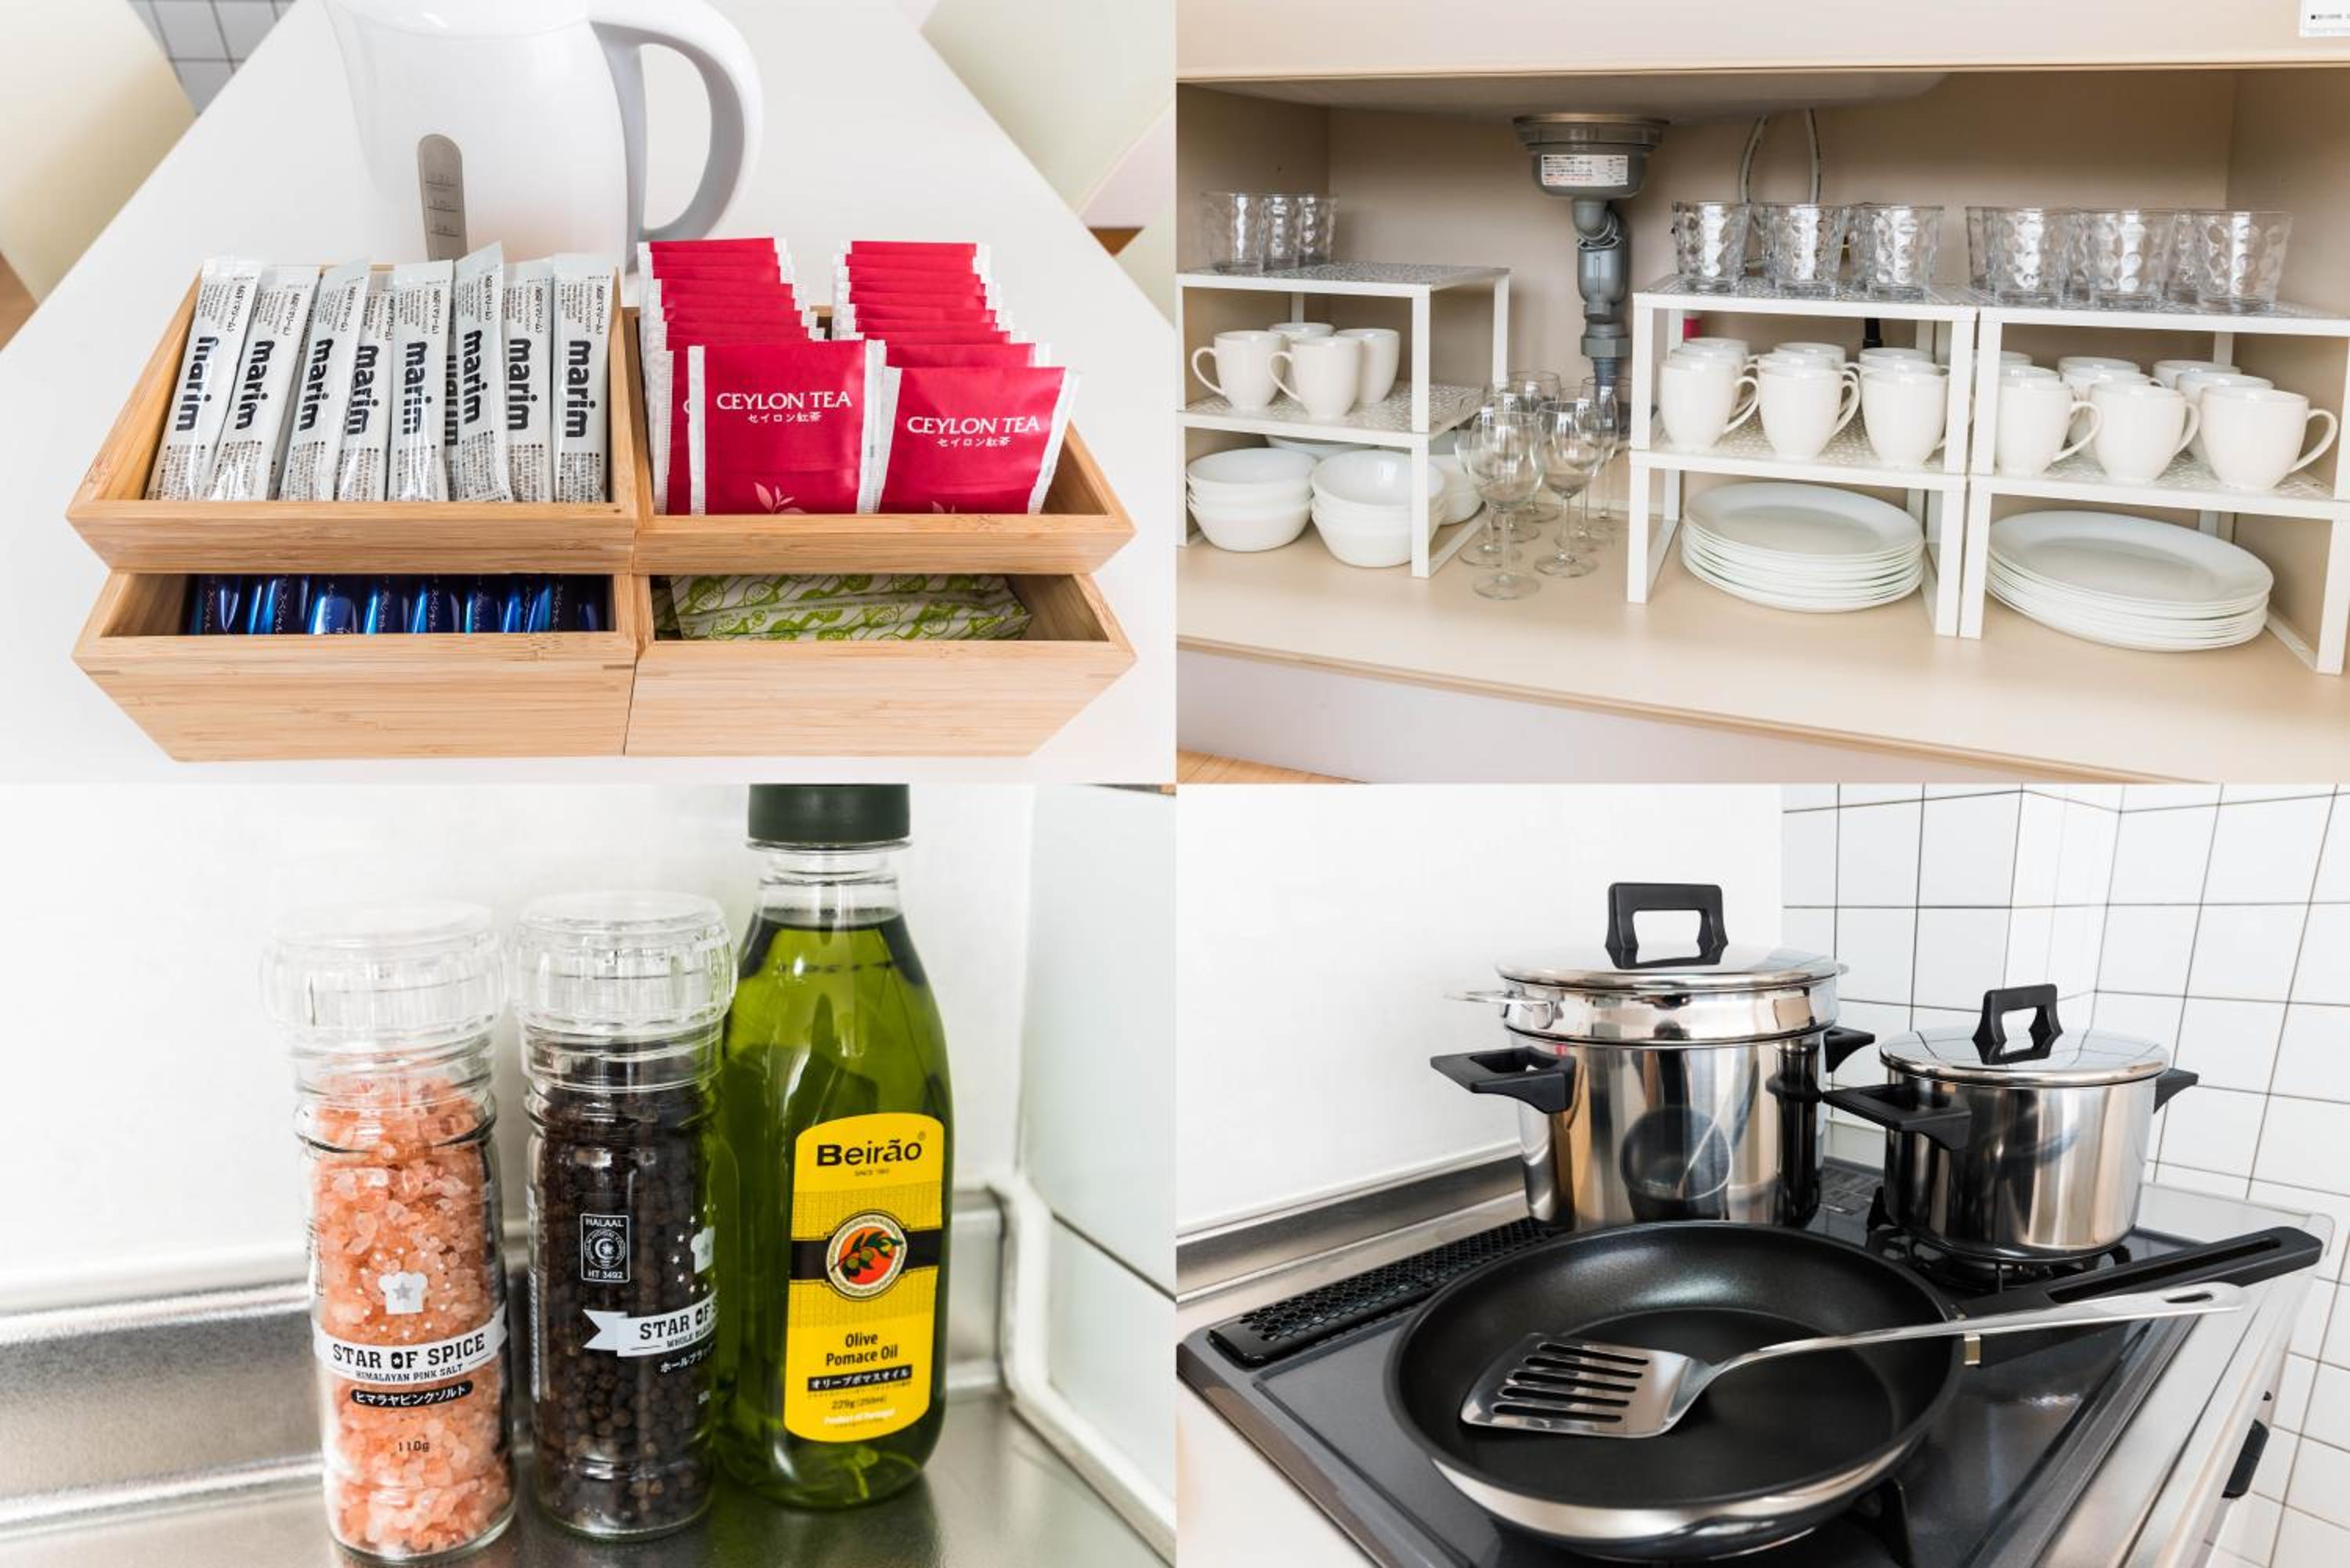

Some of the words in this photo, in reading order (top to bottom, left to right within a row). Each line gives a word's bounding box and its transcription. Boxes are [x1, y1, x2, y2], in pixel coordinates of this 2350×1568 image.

[175, 335, 219, 432] marim
[235, 339, 275, 431] marim
[298, 337, 334, 432] marim
[347, 345, 380, 435] marim
[402, 341, 432, 435] marim
[463, 330, 488, 425] marim
[508, 338, 537, 432] marim
[565, 340, 597, 438] marim
[717, 392, 806, 411] CEYLON
[810, 390, 851, 408] TEA
[747, 411, 822, 425] セイロン紅茶
[907, 417, 998, 435] CEYLON
[1002, 415, 1041, 432] TEA
[937, 435, 1011, 448] セイロン紅茶
[816, 1138, 922, 1166] Beirão
[585, 1217, 624, 1227] HALAAL
[640, 1314, 690, 1340] STAR
[696, 1303, 710, 1325] OF
[333, 1344, 381, 1367] STAR
[391, 1351, 419, 1369] OF
[428, 1333, 486, 1366] SPICE
[845, 1332, 878, 1348] Olive
[826, 1353, 878, 1366] Pomace
[881, 1344, 898, 1359] Oil
[356, 1370, 410, 1382] HIMALAYAN
[414, 1370, 437, 1381] PINK
[439, 1364, 464, 1377] SALT
[356, 1386, 467, 1406] ヒマラヤピンクソルト
[398, 1440, 430, 1452] 110g
